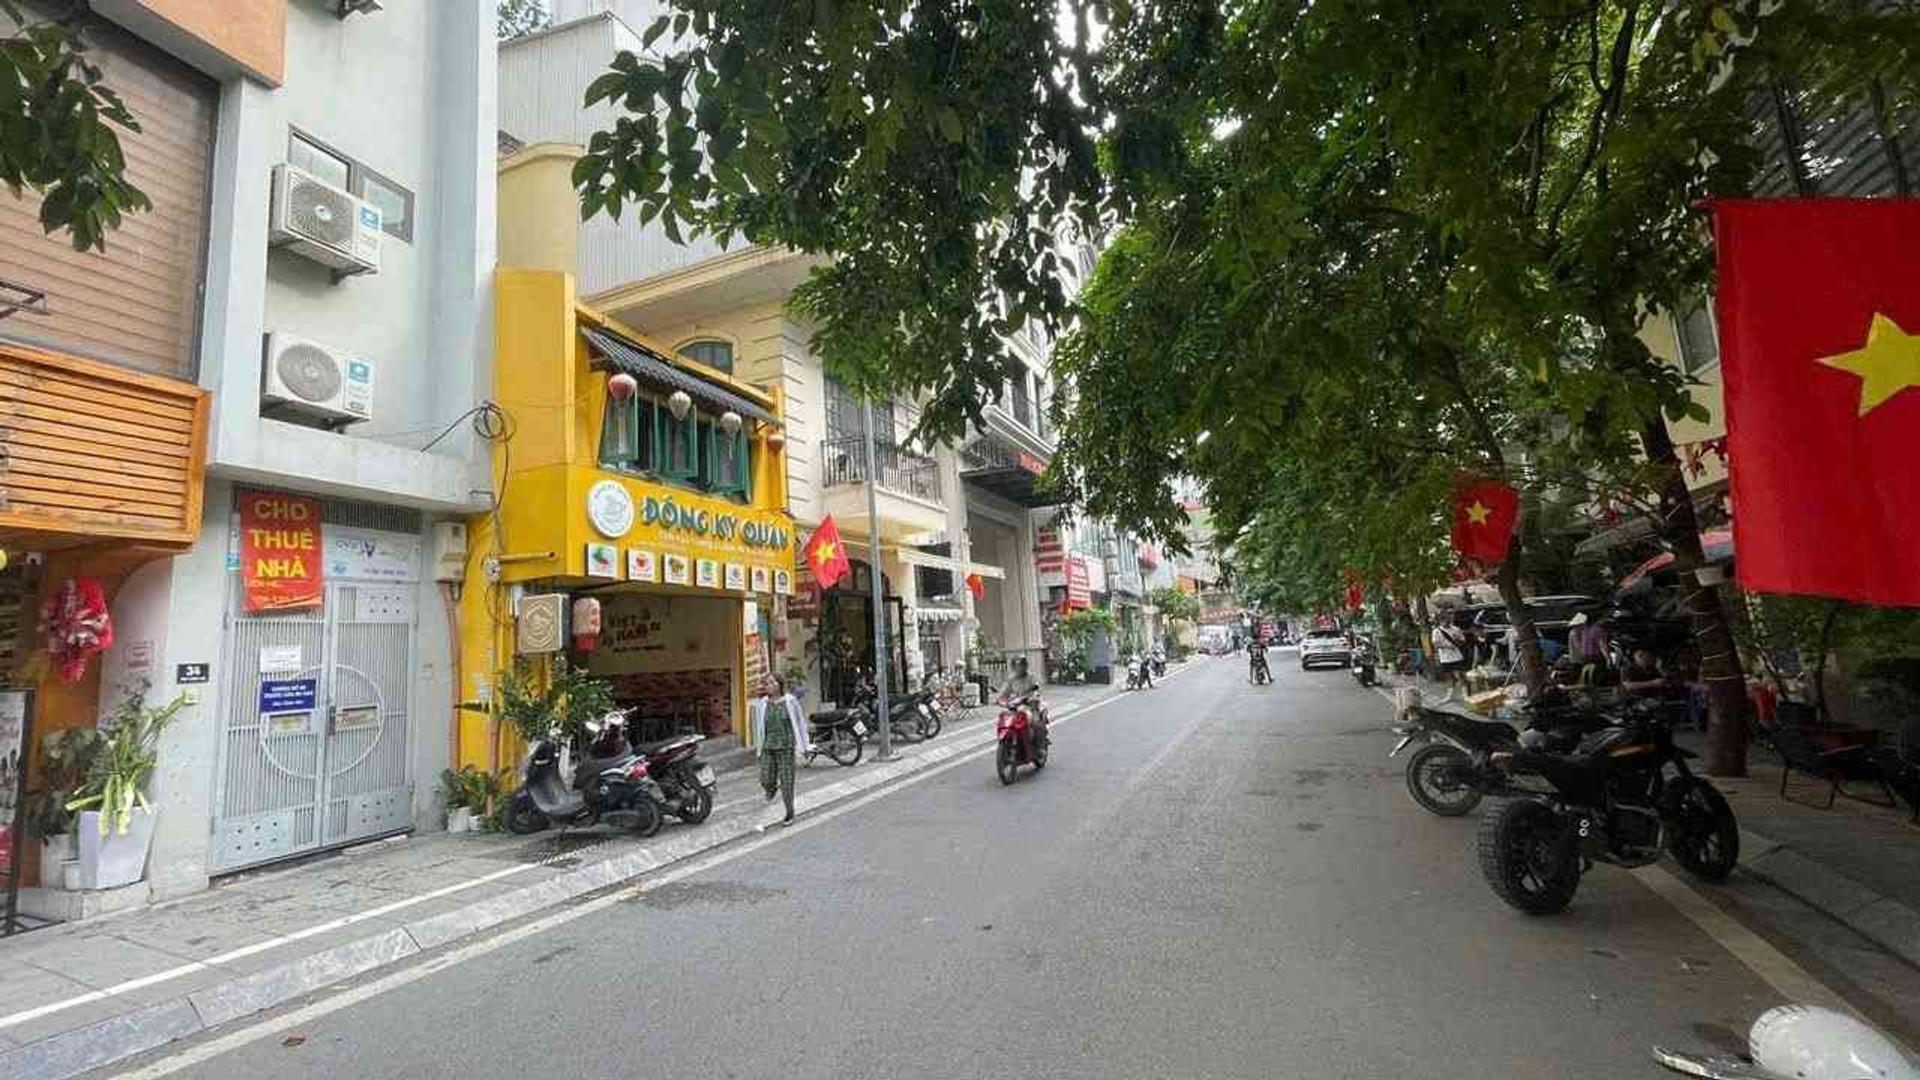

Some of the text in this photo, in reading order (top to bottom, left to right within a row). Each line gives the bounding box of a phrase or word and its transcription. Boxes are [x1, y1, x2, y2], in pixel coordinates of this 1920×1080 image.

[254, 500, 307, 520] CHO
[250, 526, 313, 551] THUÊ
[257, 555, 307, 577] NHÀ
